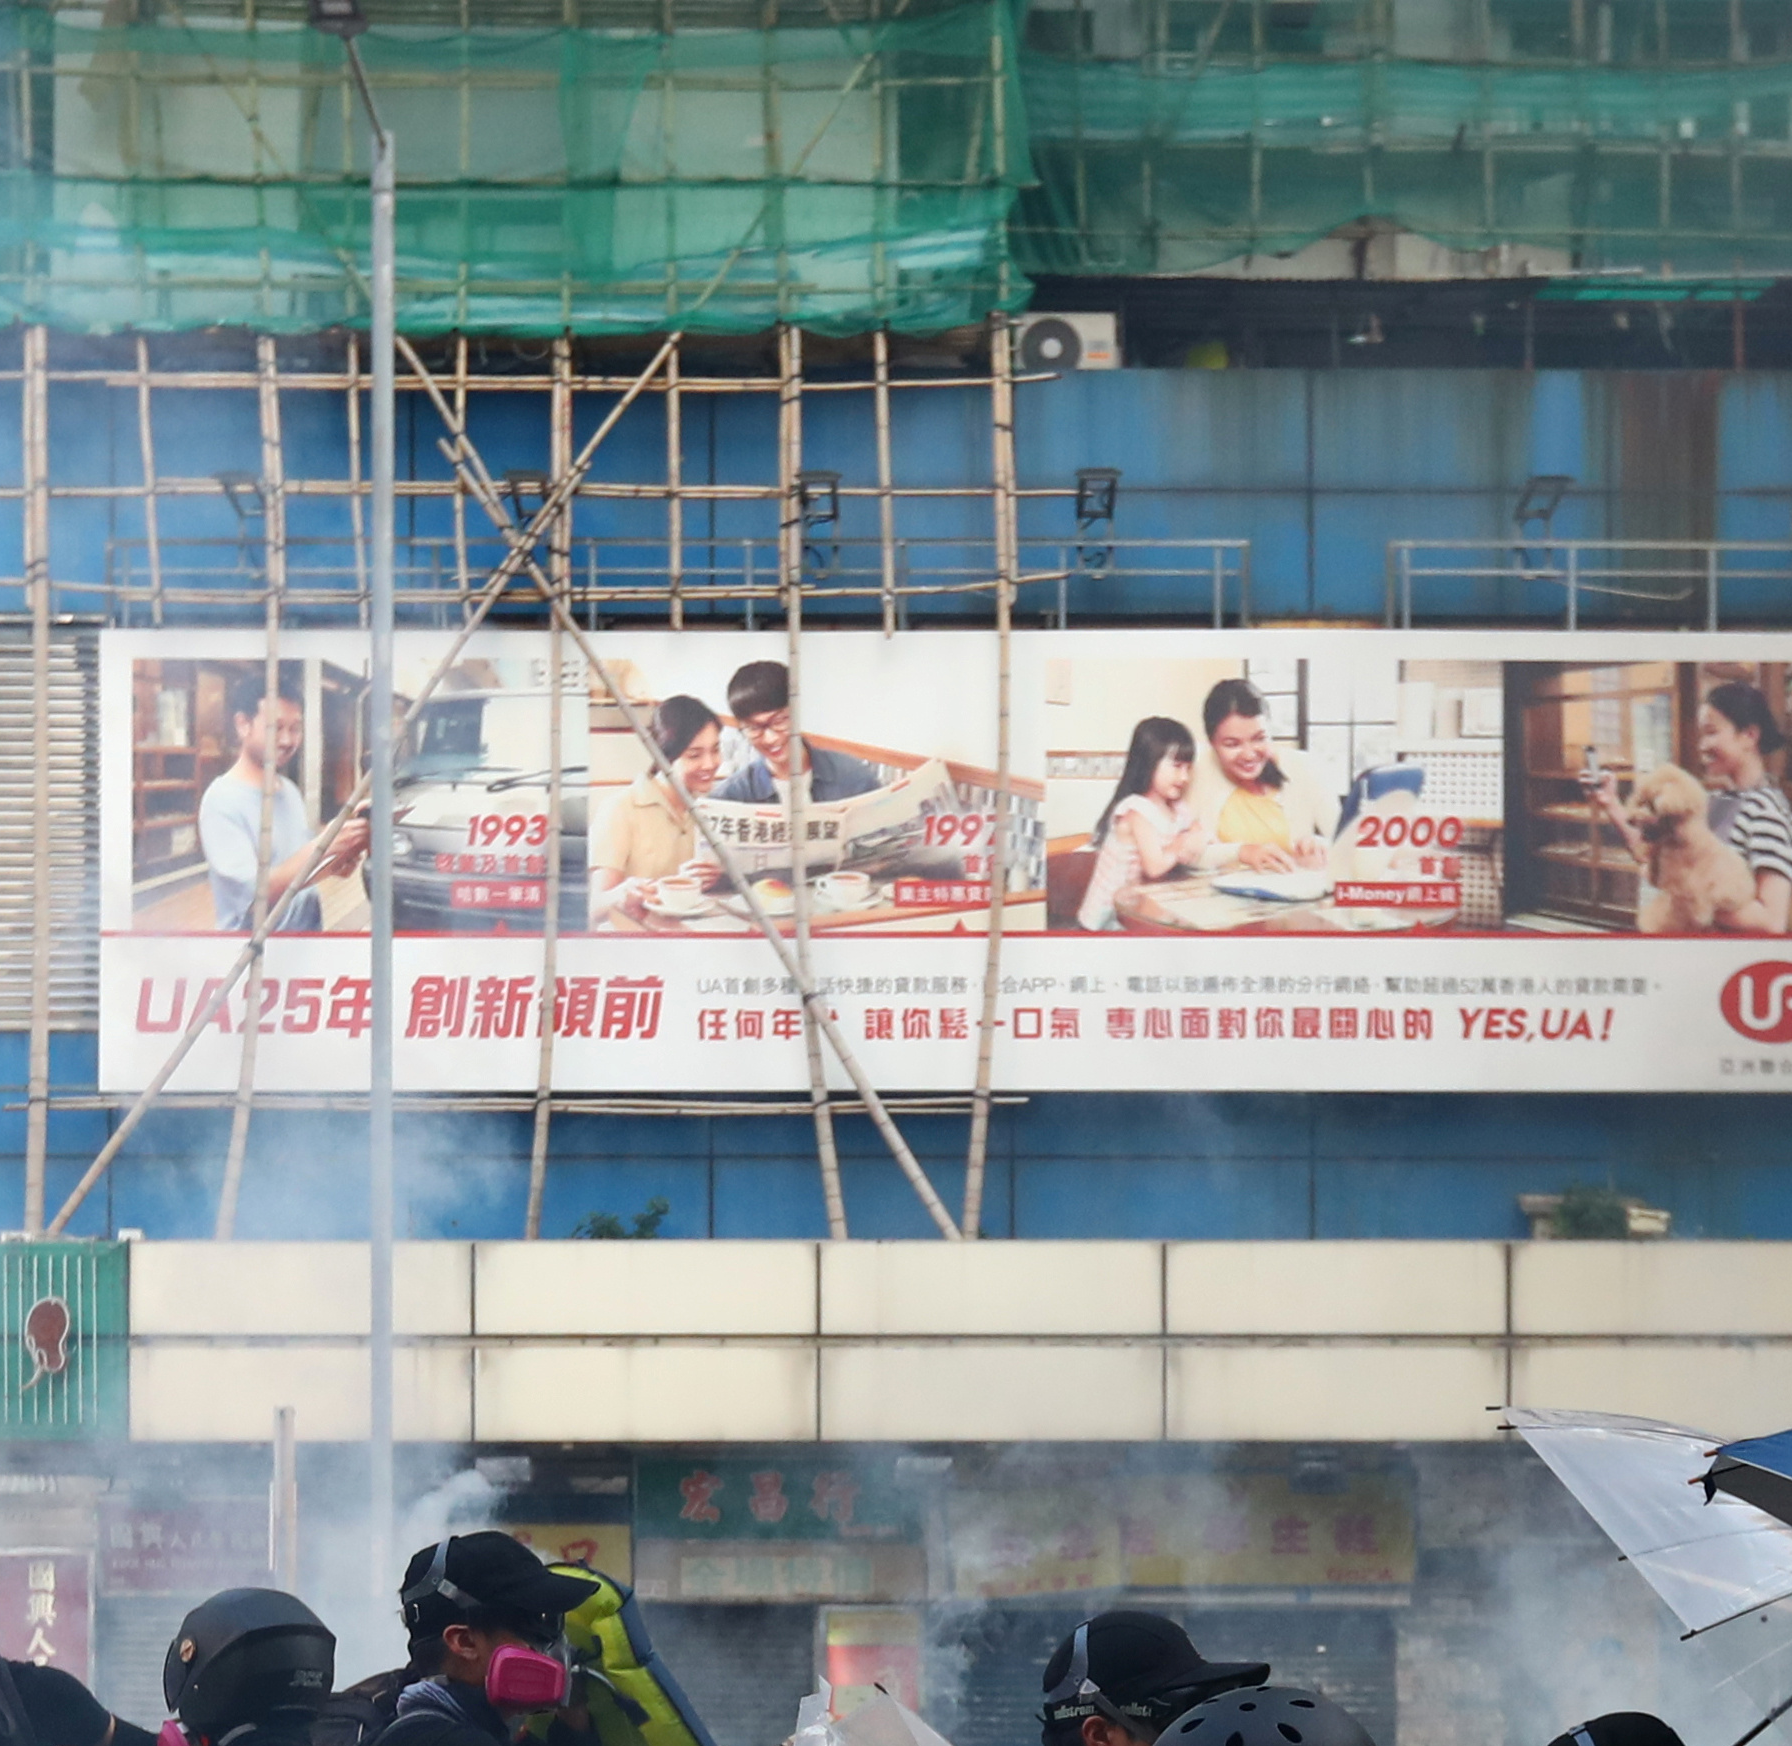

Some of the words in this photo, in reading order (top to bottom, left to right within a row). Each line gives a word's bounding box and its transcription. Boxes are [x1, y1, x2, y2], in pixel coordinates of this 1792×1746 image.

[466, 814, 549, 847] 1993
[1356, 815, 1464, 849] 2000
[697, 1008, 840, 1041] 任何年
[1458, 1007, 1615, 1043] YES,UA!
